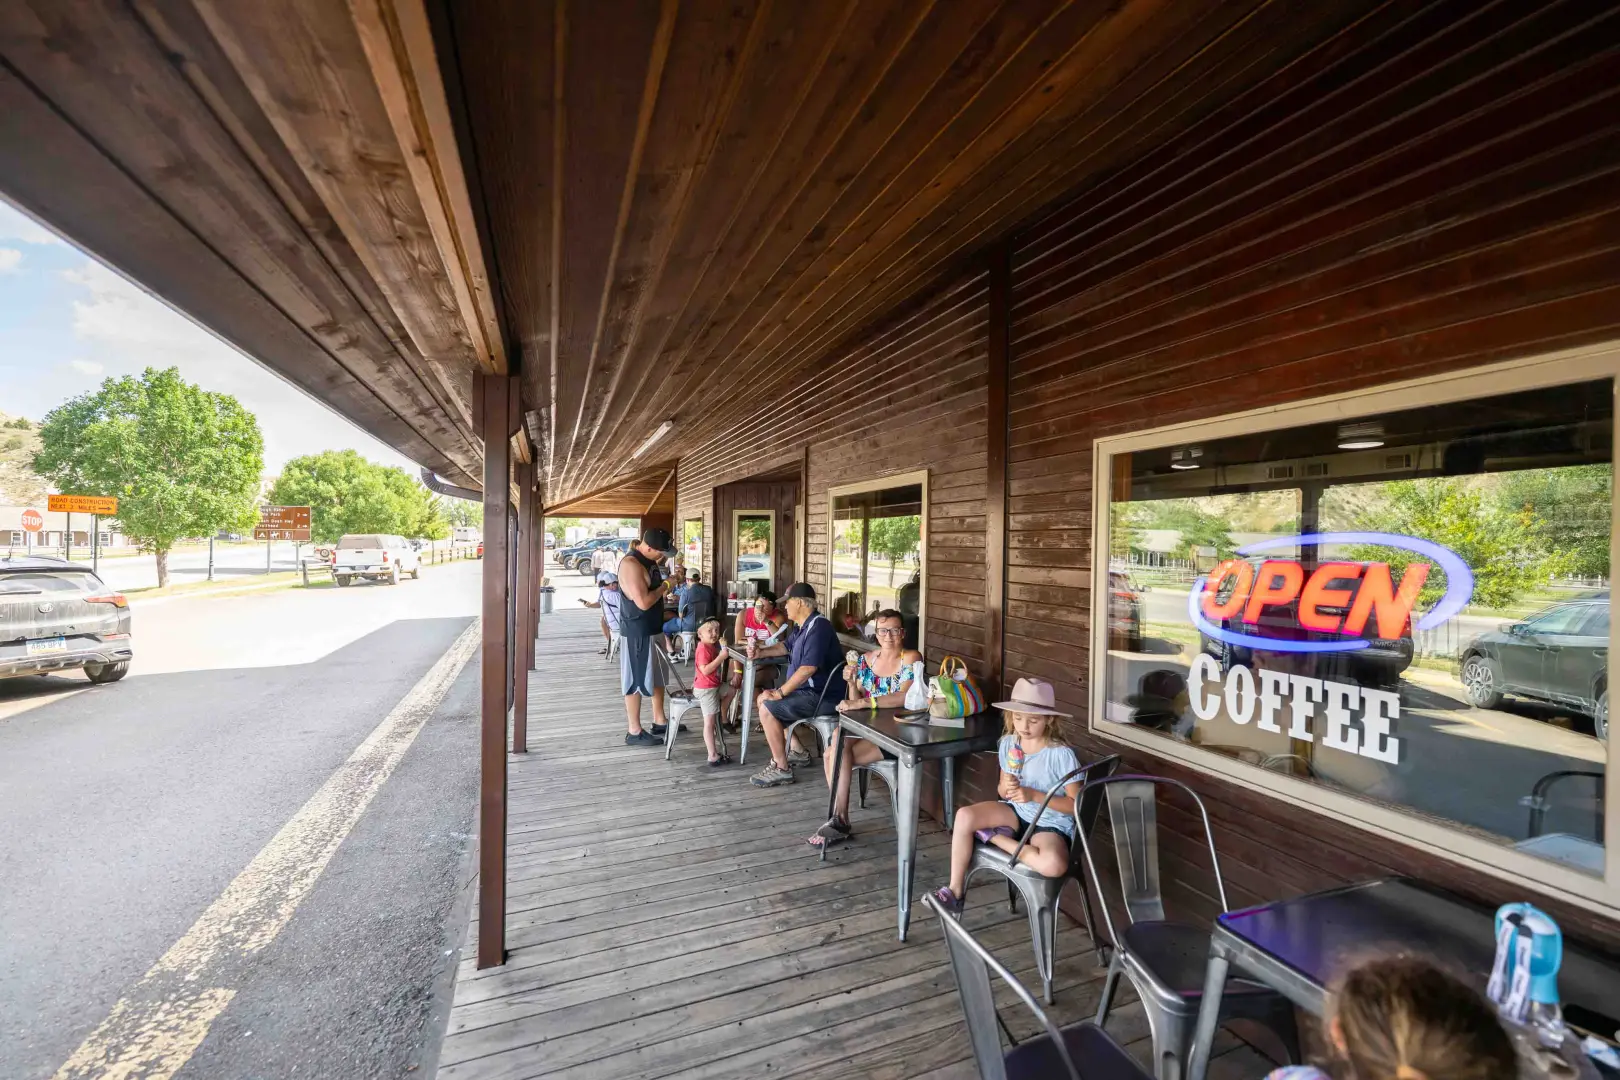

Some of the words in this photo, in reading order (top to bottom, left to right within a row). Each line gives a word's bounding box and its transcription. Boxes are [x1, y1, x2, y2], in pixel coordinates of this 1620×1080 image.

[22, 515, 42, 527] STOP
[1202, 559, 1431, 640] OPEN
[1186, 653, 1400, 765] COFFEE
